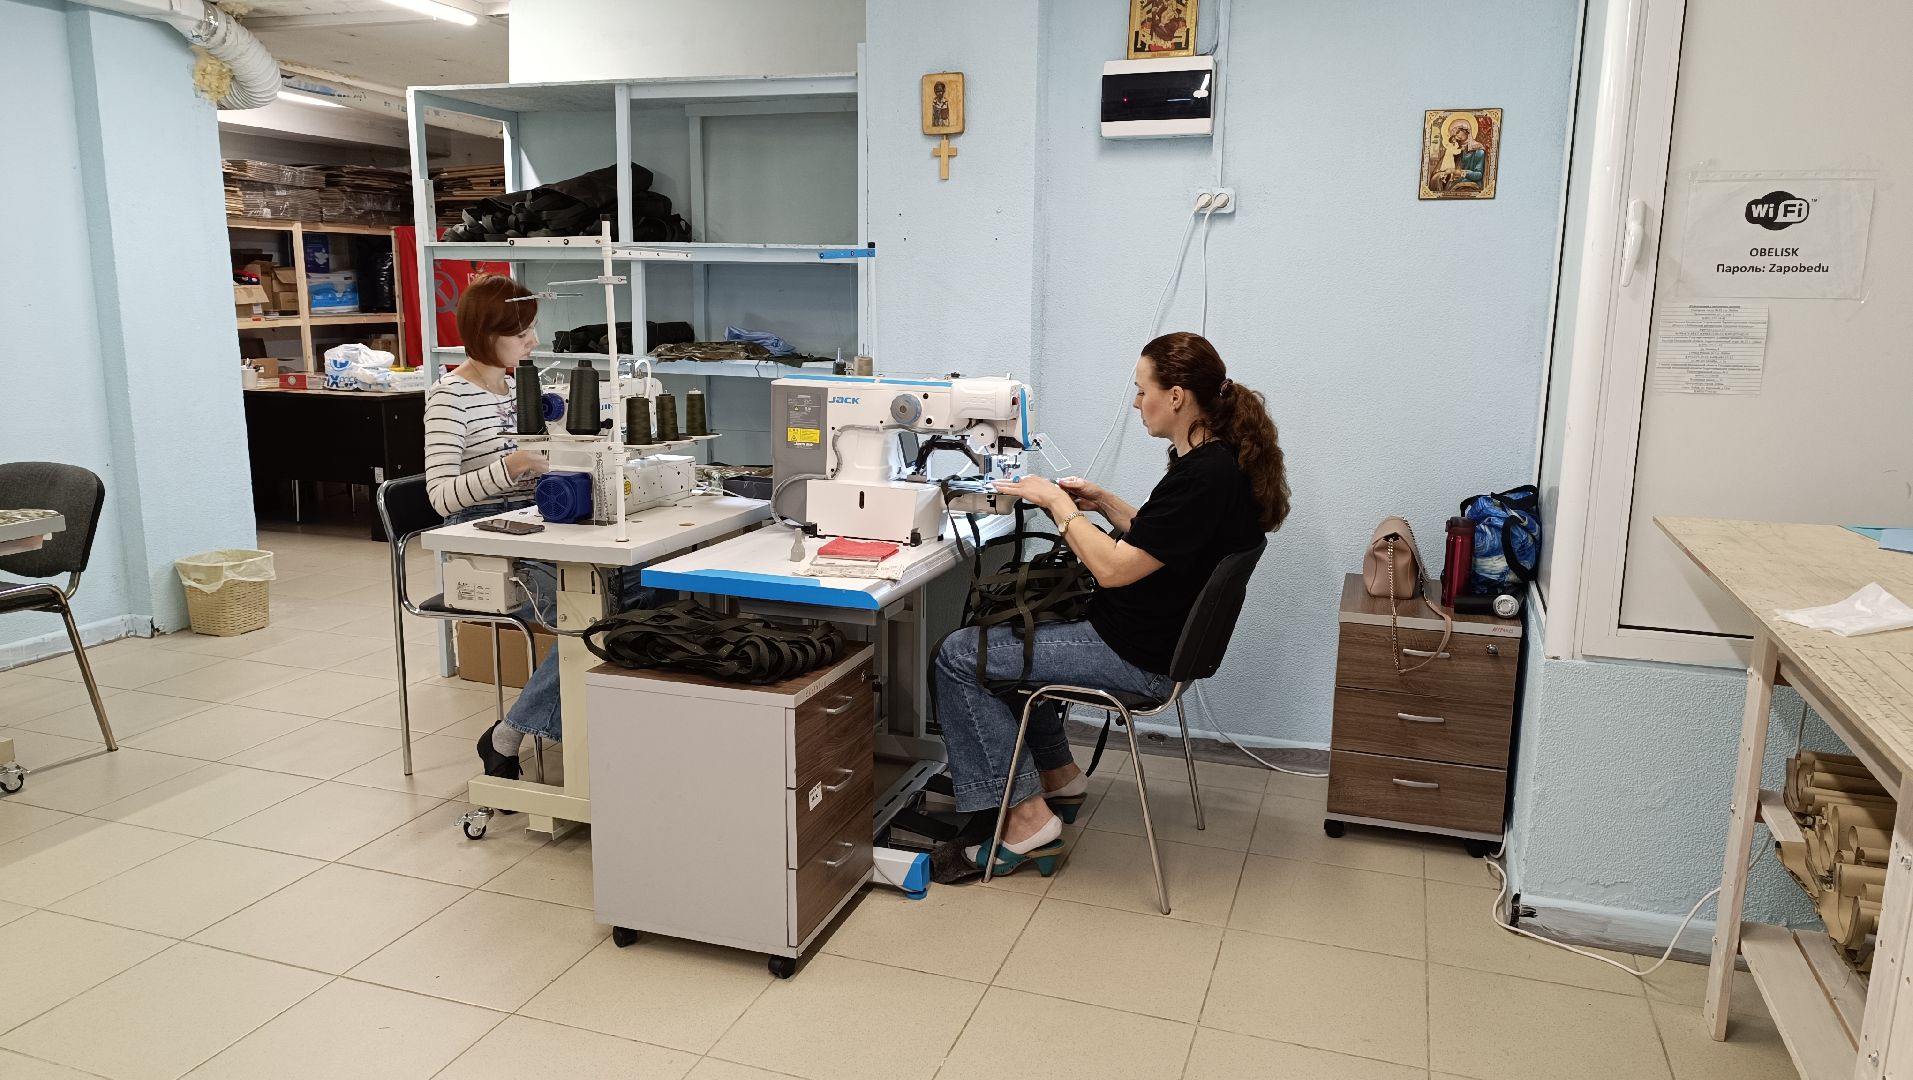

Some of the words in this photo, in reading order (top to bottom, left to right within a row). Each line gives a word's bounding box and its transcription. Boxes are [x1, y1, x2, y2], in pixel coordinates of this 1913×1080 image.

[1749, 247, 1800, 257] OBELISK
[1716, 263, 1766, 275] Пароль:
[1768, 262, 1829, 275] Zapobedu
